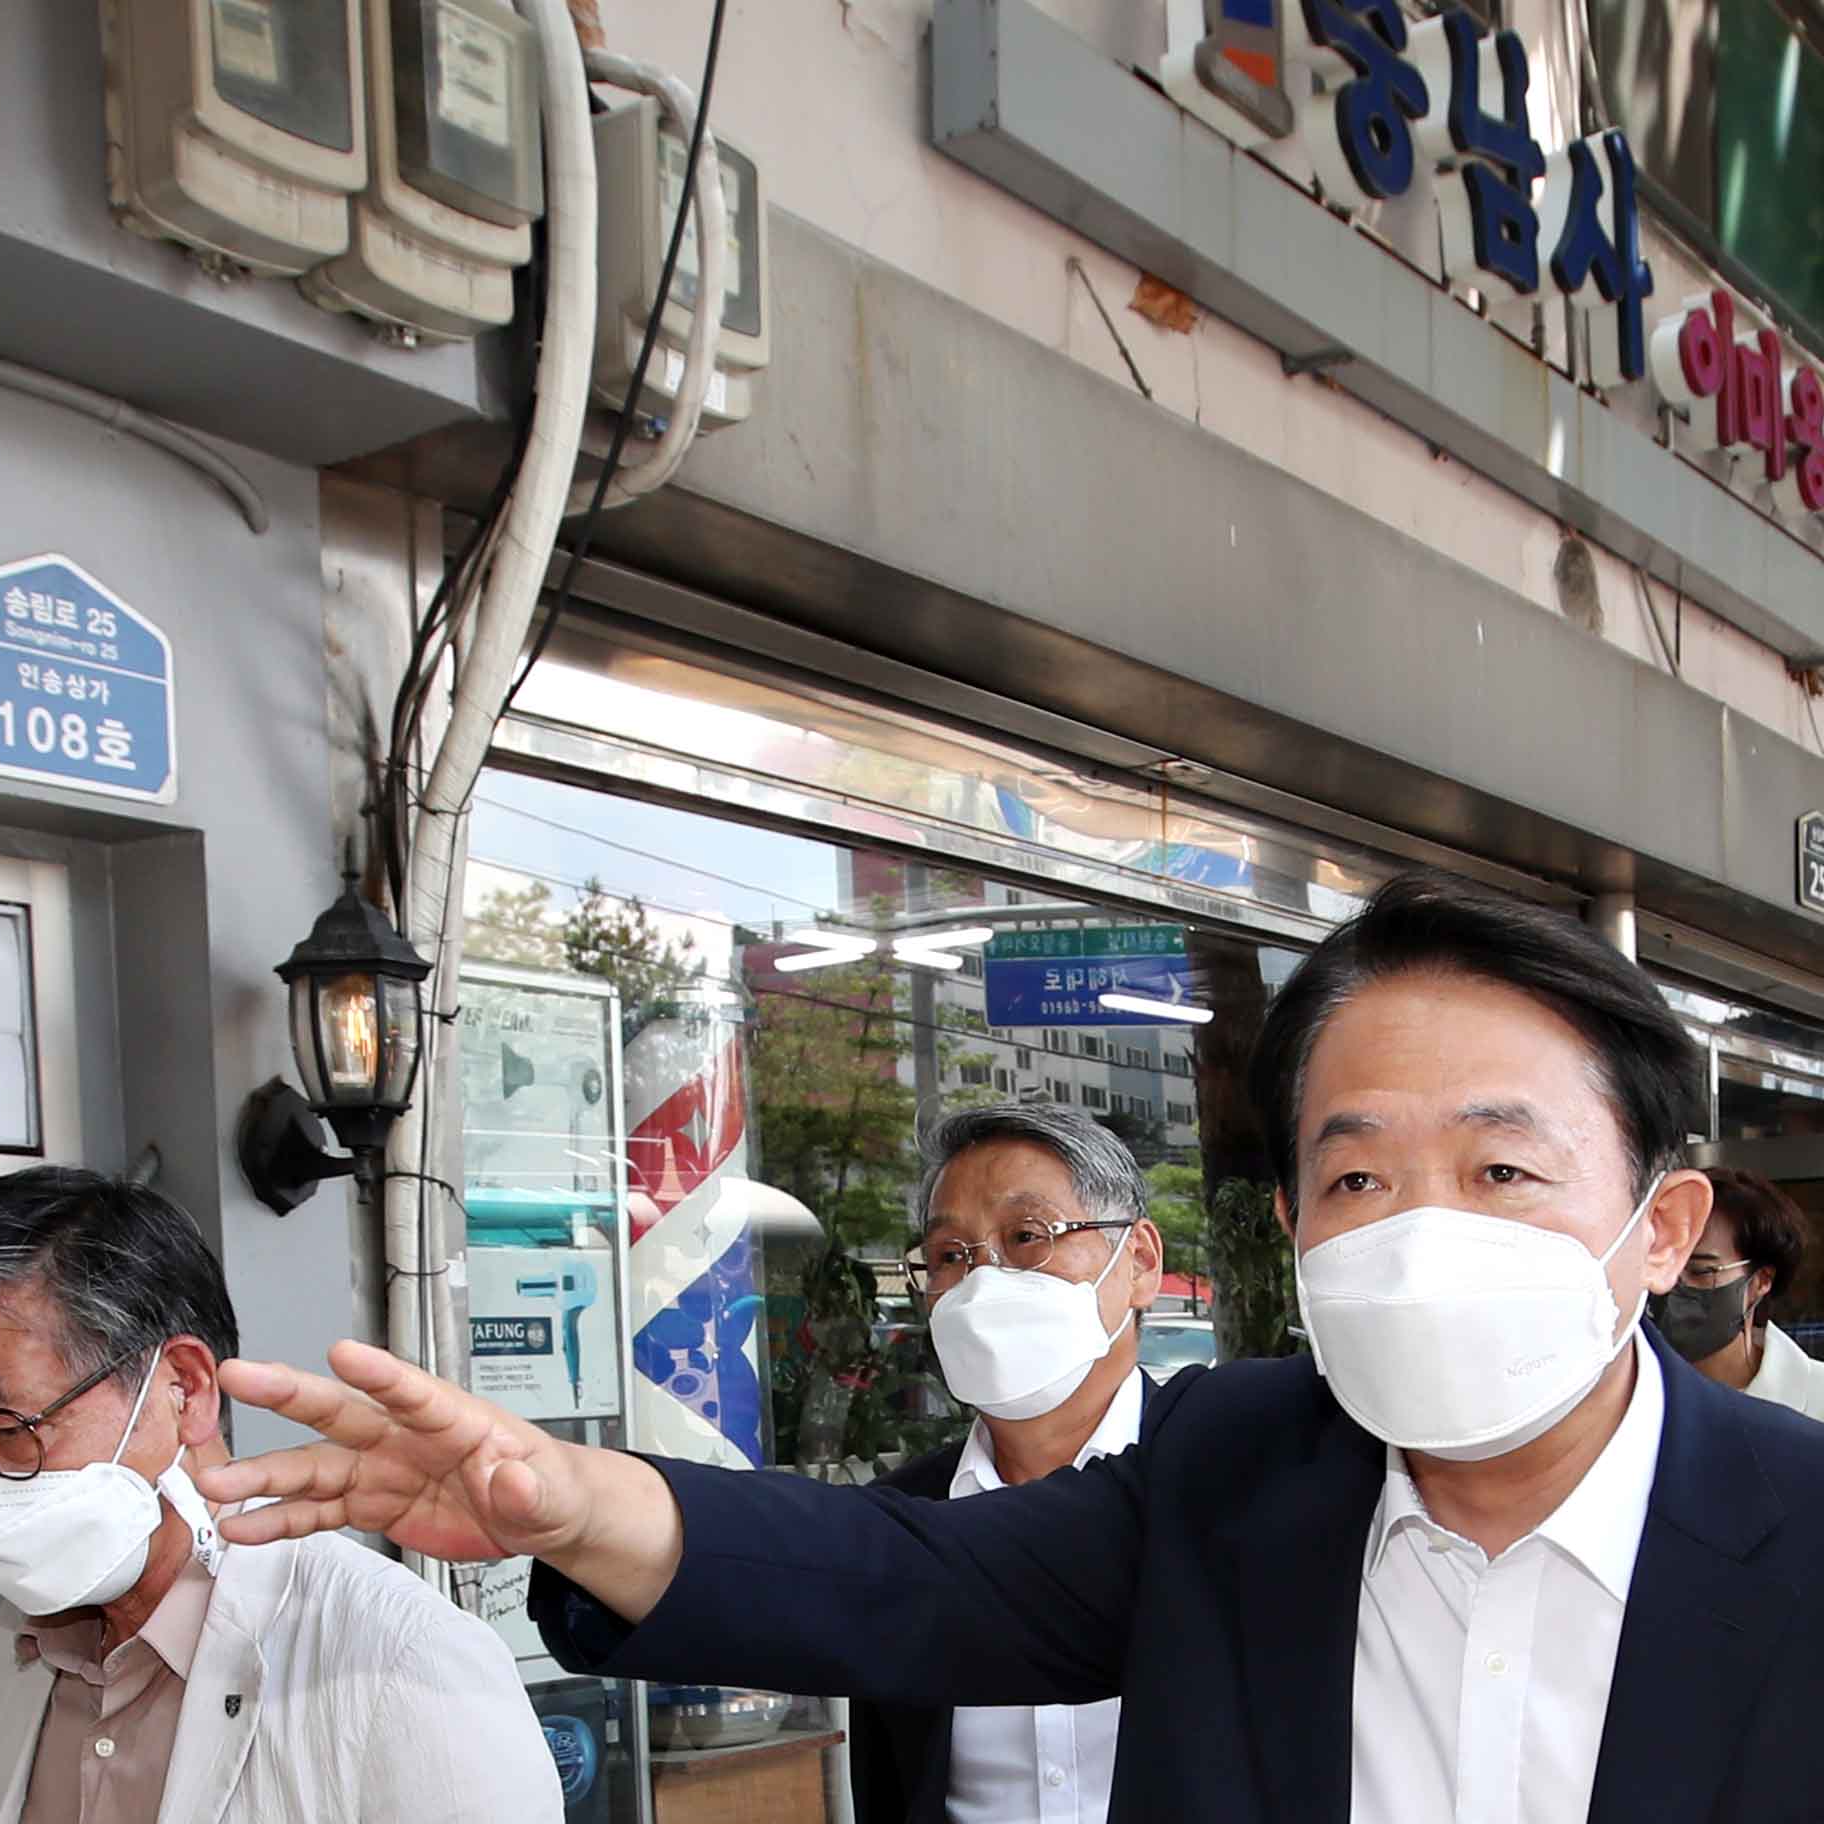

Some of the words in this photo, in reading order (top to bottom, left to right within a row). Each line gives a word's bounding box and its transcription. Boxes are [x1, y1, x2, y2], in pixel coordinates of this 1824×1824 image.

[3, 586, 80, 630] 송림로
[86, 606, 118, 639] 25
[100, 640, 120, 662] 25
[17, 662, 111, 705] 인송상가
